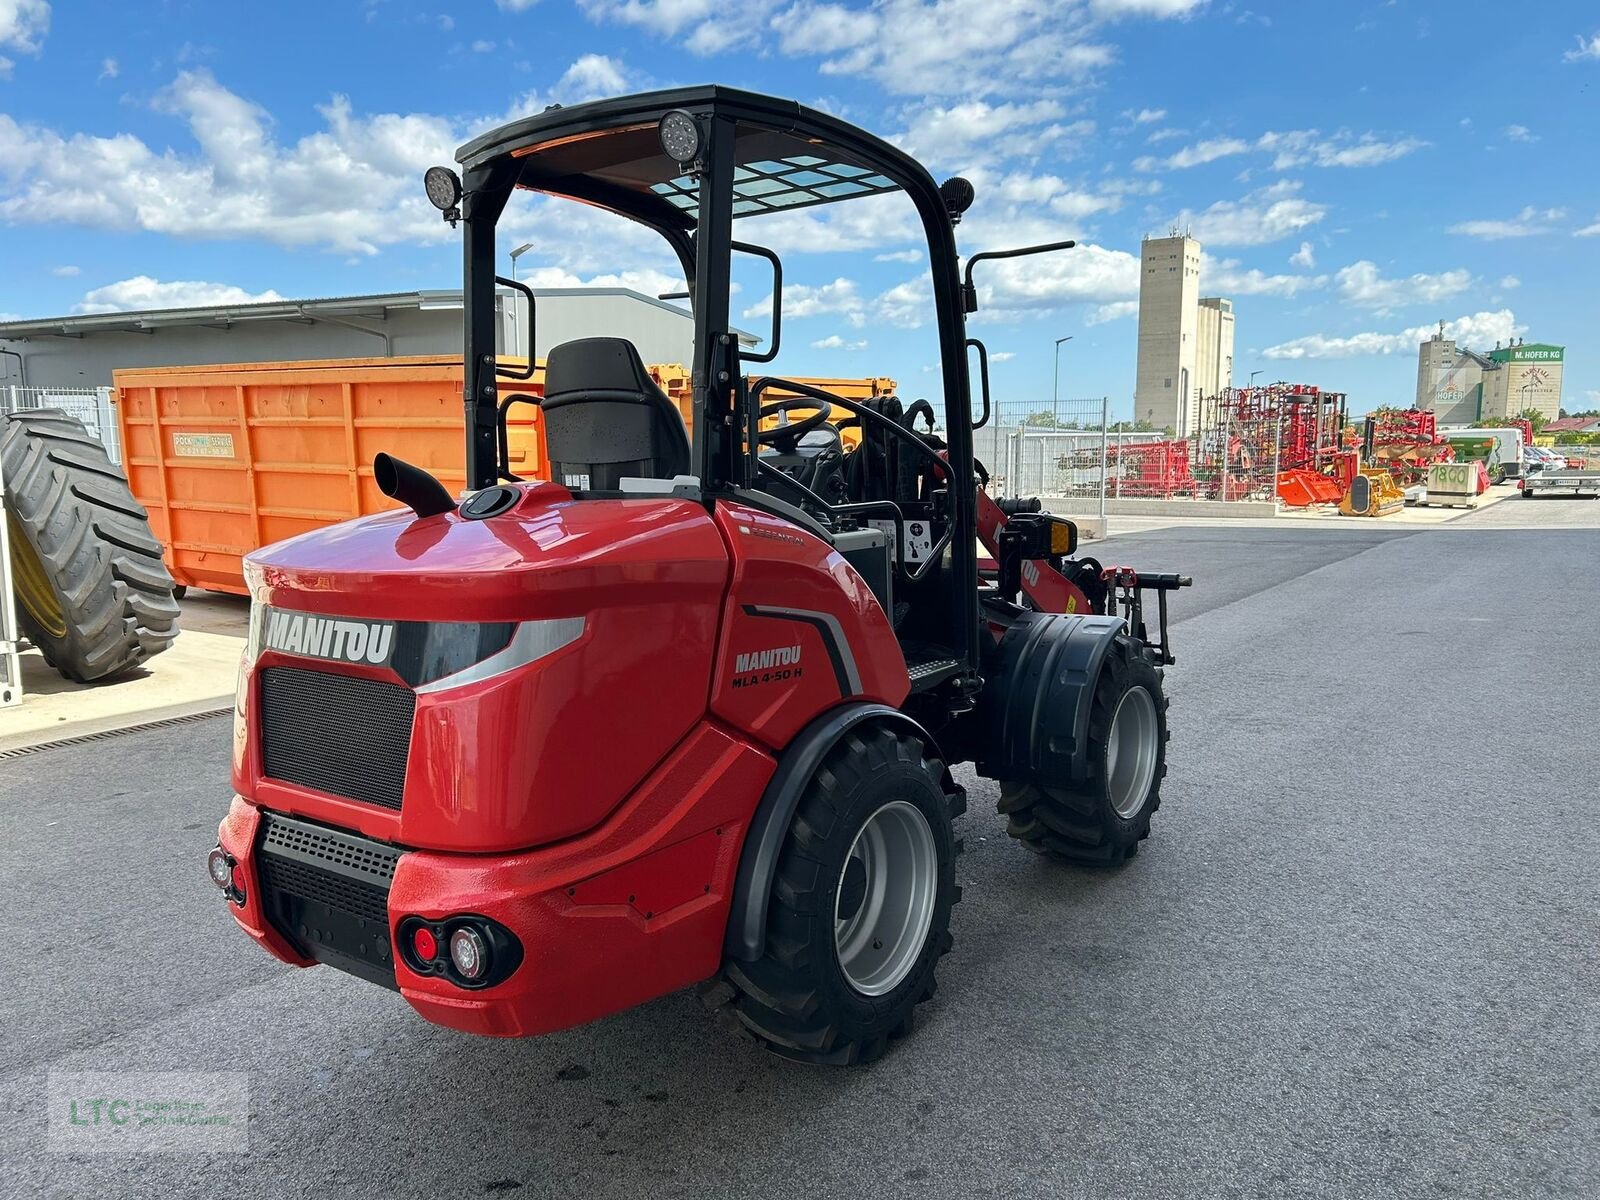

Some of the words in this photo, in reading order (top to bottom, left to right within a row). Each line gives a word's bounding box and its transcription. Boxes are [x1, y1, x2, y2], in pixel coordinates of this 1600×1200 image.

[1514, 351, 1524, 359] M.
[1525, 351, 1549, 359] HOFER
[1550, 350, 1560, 358] KG
[1436, 391, 1464, 400] HOFER
[266, 611, 394, 665] MANITOU
[735, 645, 802, 674] MANITOU
[732, 675, 759, 689] MLA
[761, 669, 792, 683] 4-50
[794, 667, 803, 678] H
